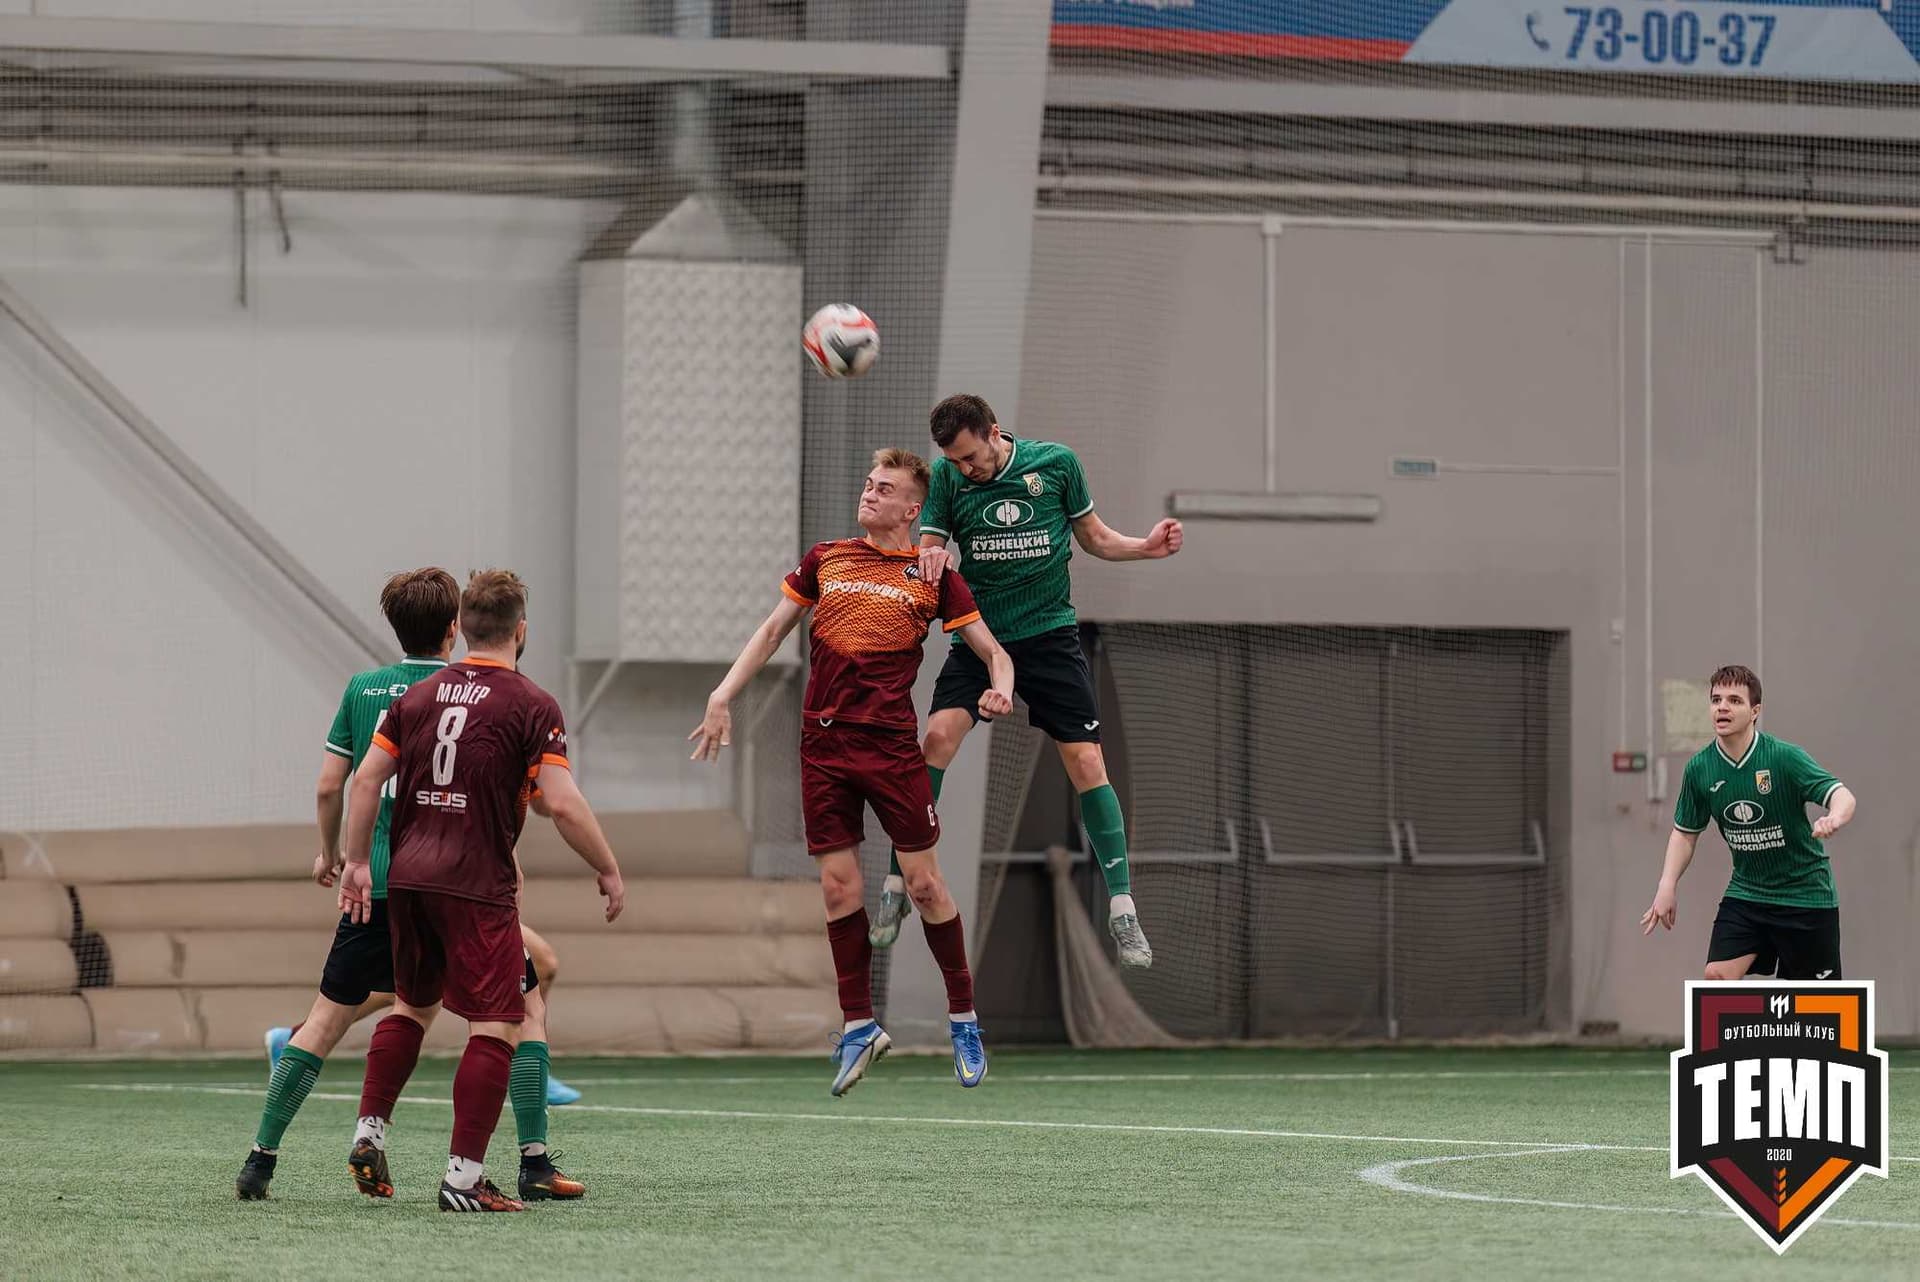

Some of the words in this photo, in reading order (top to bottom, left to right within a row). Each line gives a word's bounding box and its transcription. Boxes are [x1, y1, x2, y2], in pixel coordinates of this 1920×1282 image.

[1564, 7, 1776, 67] 73-00-37
[972, 534, 1050, 551] КУЗНЕЦКИЕ
[972, 546, 1051, 561] ФЕРРОСПЛАВЫ
[436, 681, 491, 704] МАЙЕР
[432, 706, 468, 786] 8
